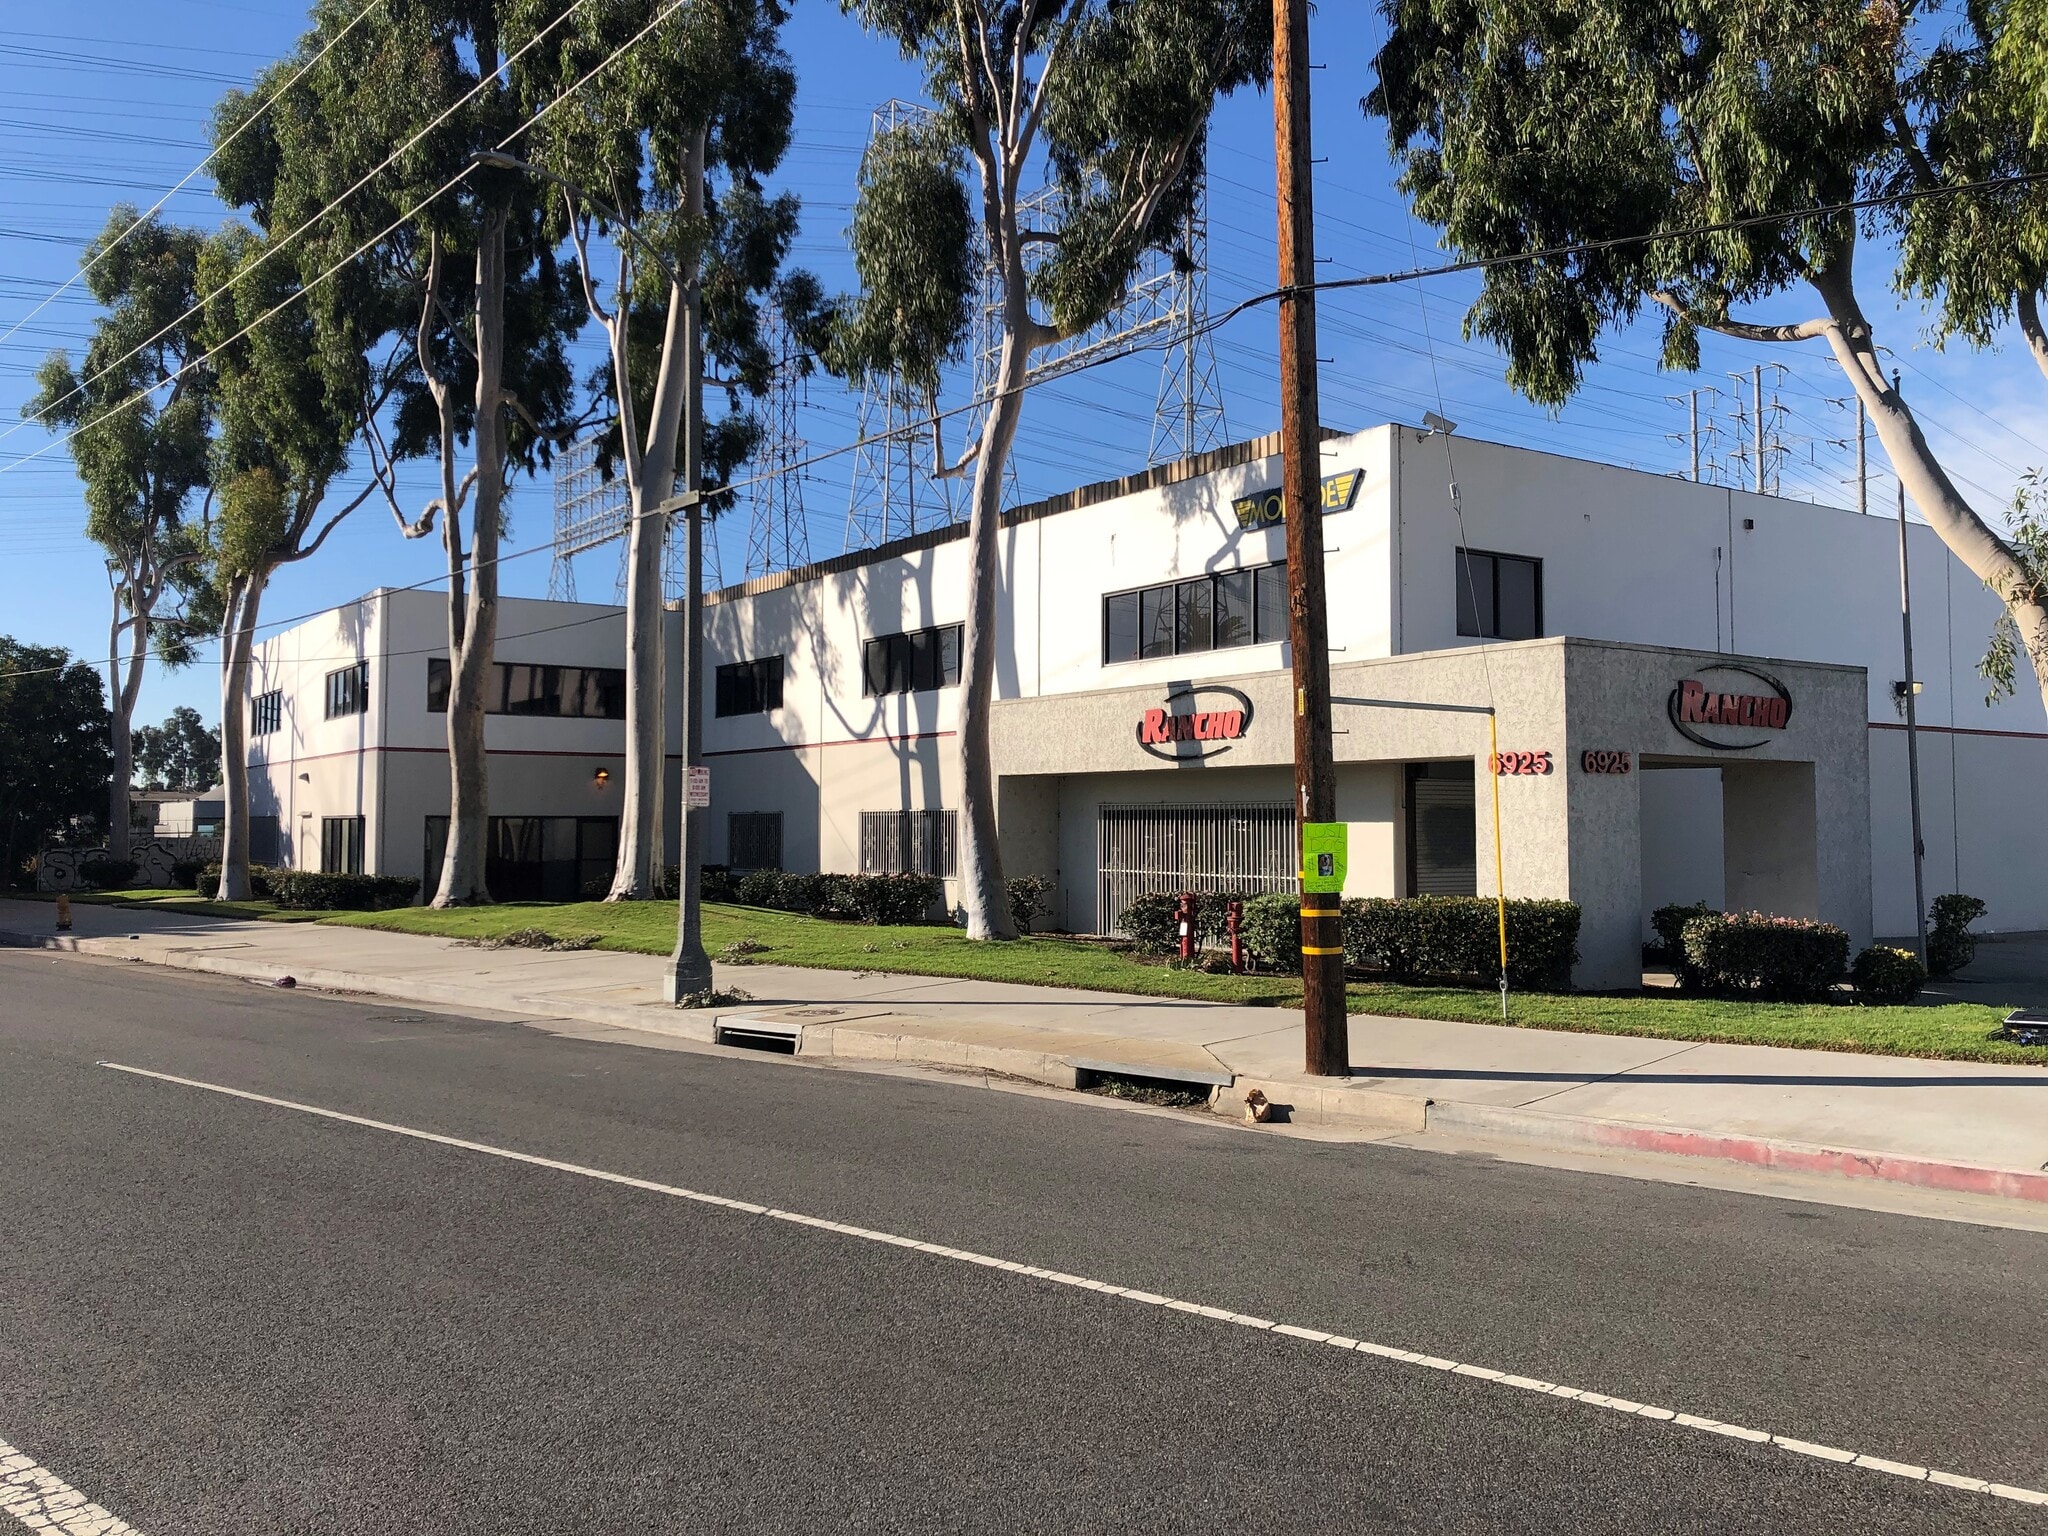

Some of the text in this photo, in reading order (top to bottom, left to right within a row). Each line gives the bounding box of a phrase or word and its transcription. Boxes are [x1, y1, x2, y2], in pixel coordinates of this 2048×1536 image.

[1681, 680, 1786, 729] RANCHO
[1142, 709, 1241, 743] RANCHO
[1488, 752, 1549, 774] 6925
[1583, 752, 1631, 773] 6925
[1306, 824, 1346, 838] LOST
[1311, 838, 1345, 852] DOG
